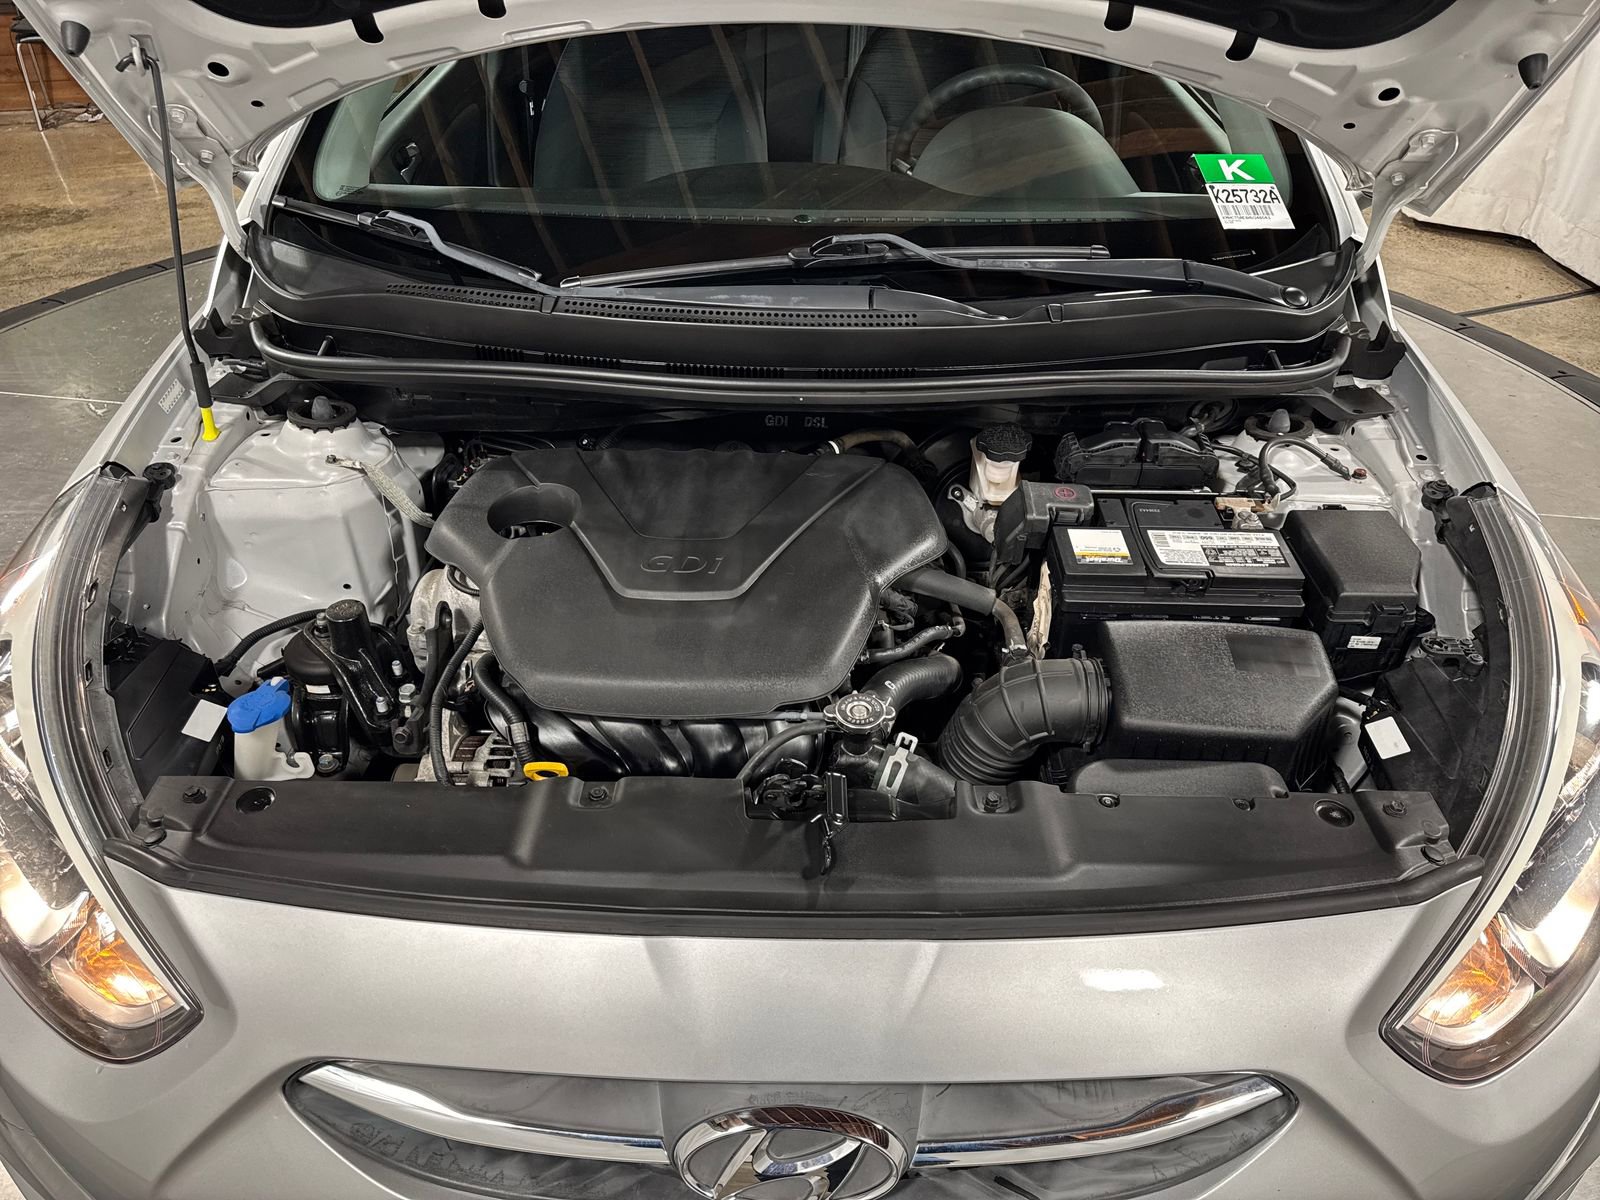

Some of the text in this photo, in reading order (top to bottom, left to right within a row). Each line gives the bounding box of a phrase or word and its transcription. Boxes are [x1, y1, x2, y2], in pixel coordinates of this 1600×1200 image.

[1218, 159, 1256, 180] K
[1211, 188, 1281, 204] K25732A
[765, 414, 829, 428] GDI DSL
